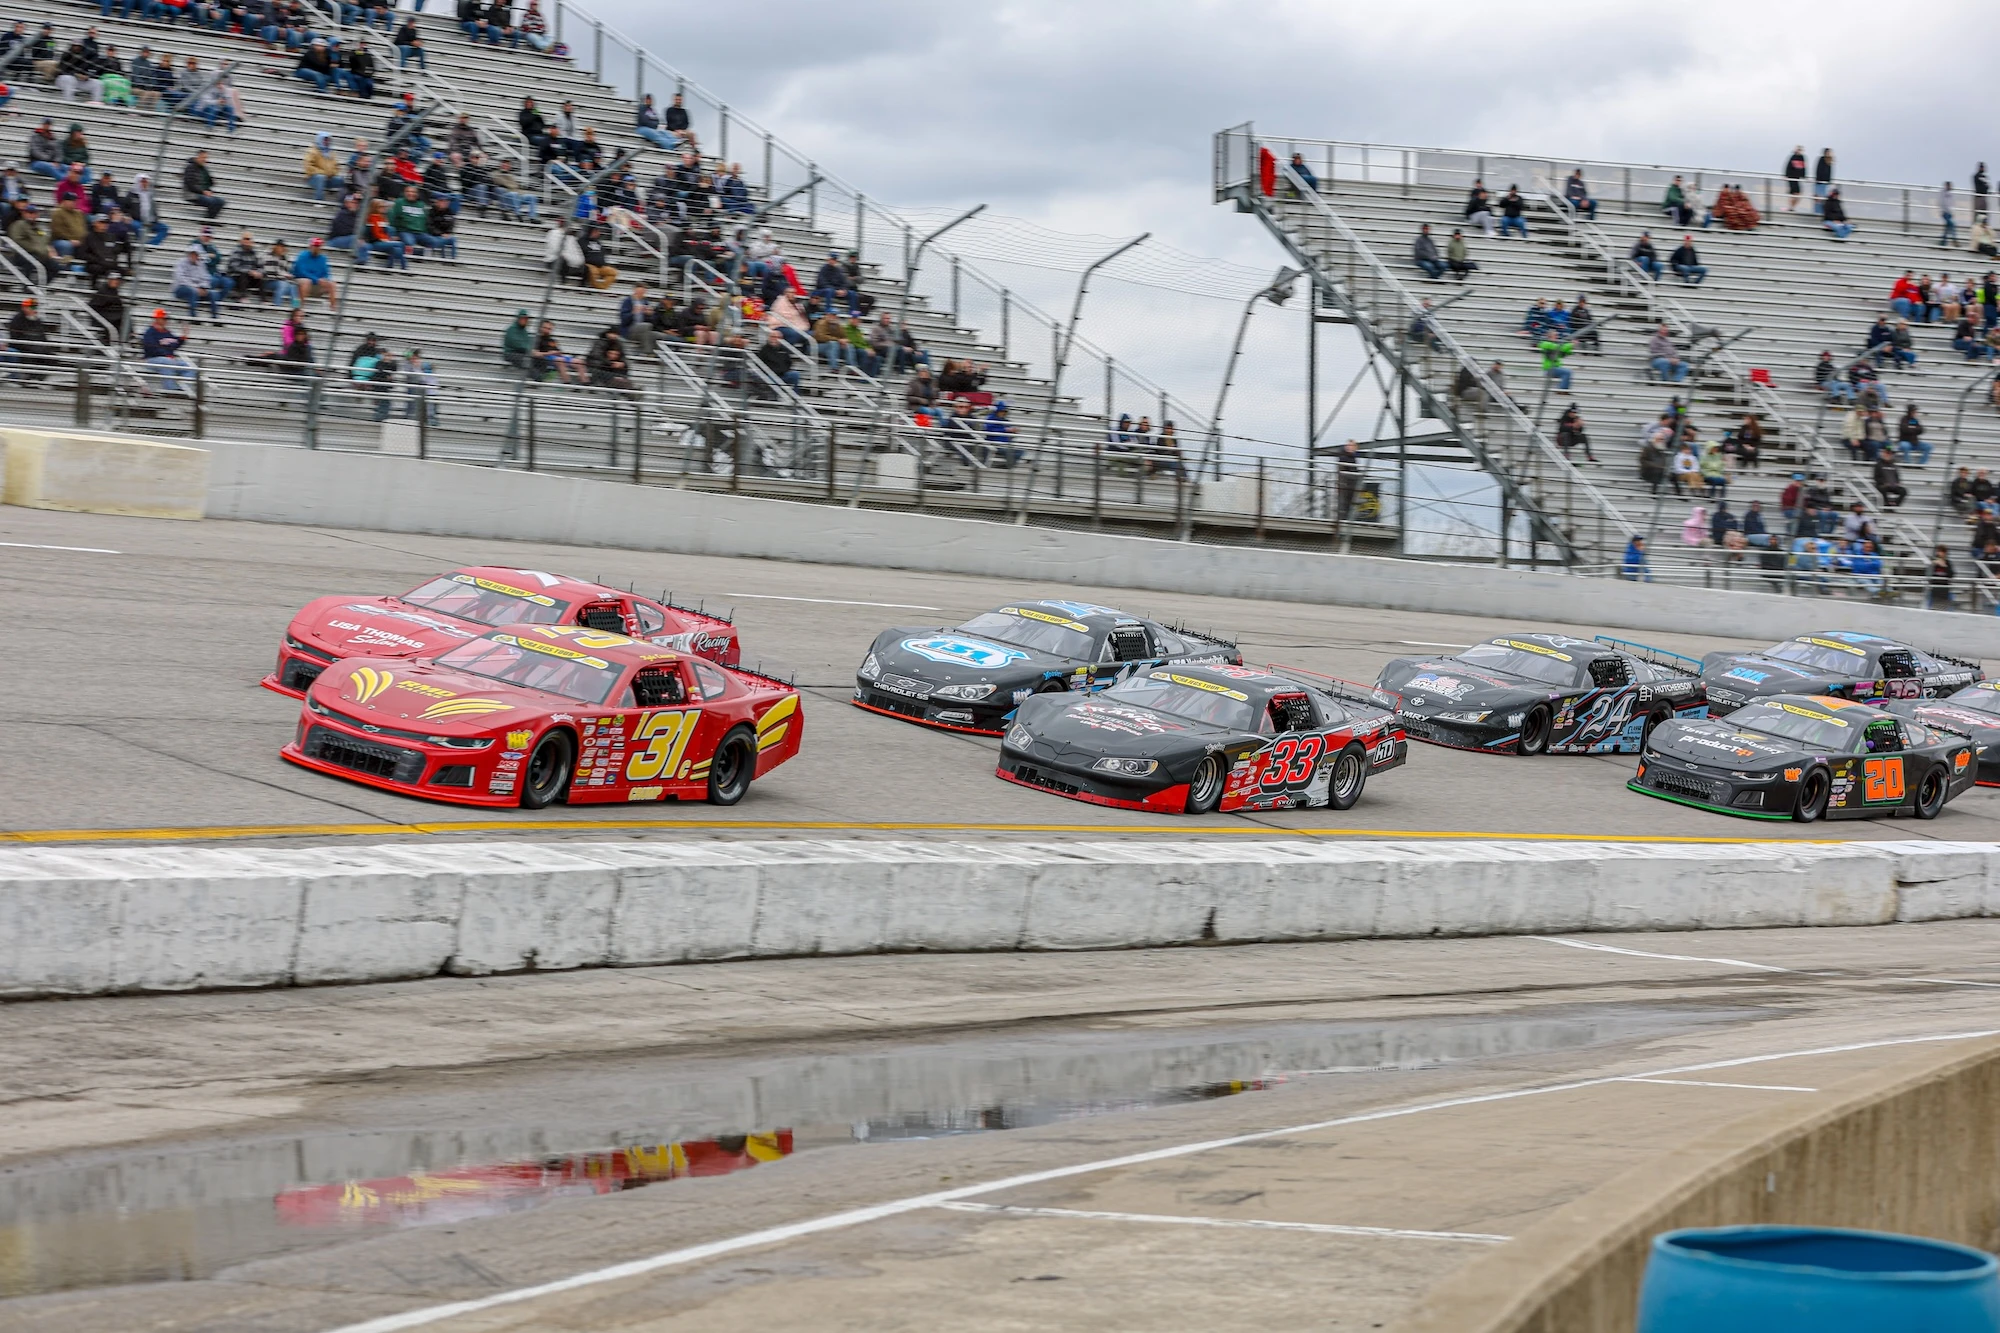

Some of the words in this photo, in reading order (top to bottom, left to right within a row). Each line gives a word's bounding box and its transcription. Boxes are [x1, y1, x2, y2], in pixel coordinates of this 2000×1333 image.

[328, 620, 362, 631] LISA
[364, 627, 425, 648] THOMAS
[694, 631, 731, 655] Racing
[873, 682, 916, 698] CHEVROLET
[916, 693, 930, 701] SS
[1653, 682, 1693, 694] HUTCHERSON
[1396, 709, 1431, 721] AMRY
[1580, 693, 1637, 740] 24
[1261, 736, 1323, 786] 33
[1865, 757, 1905, 802] 20
